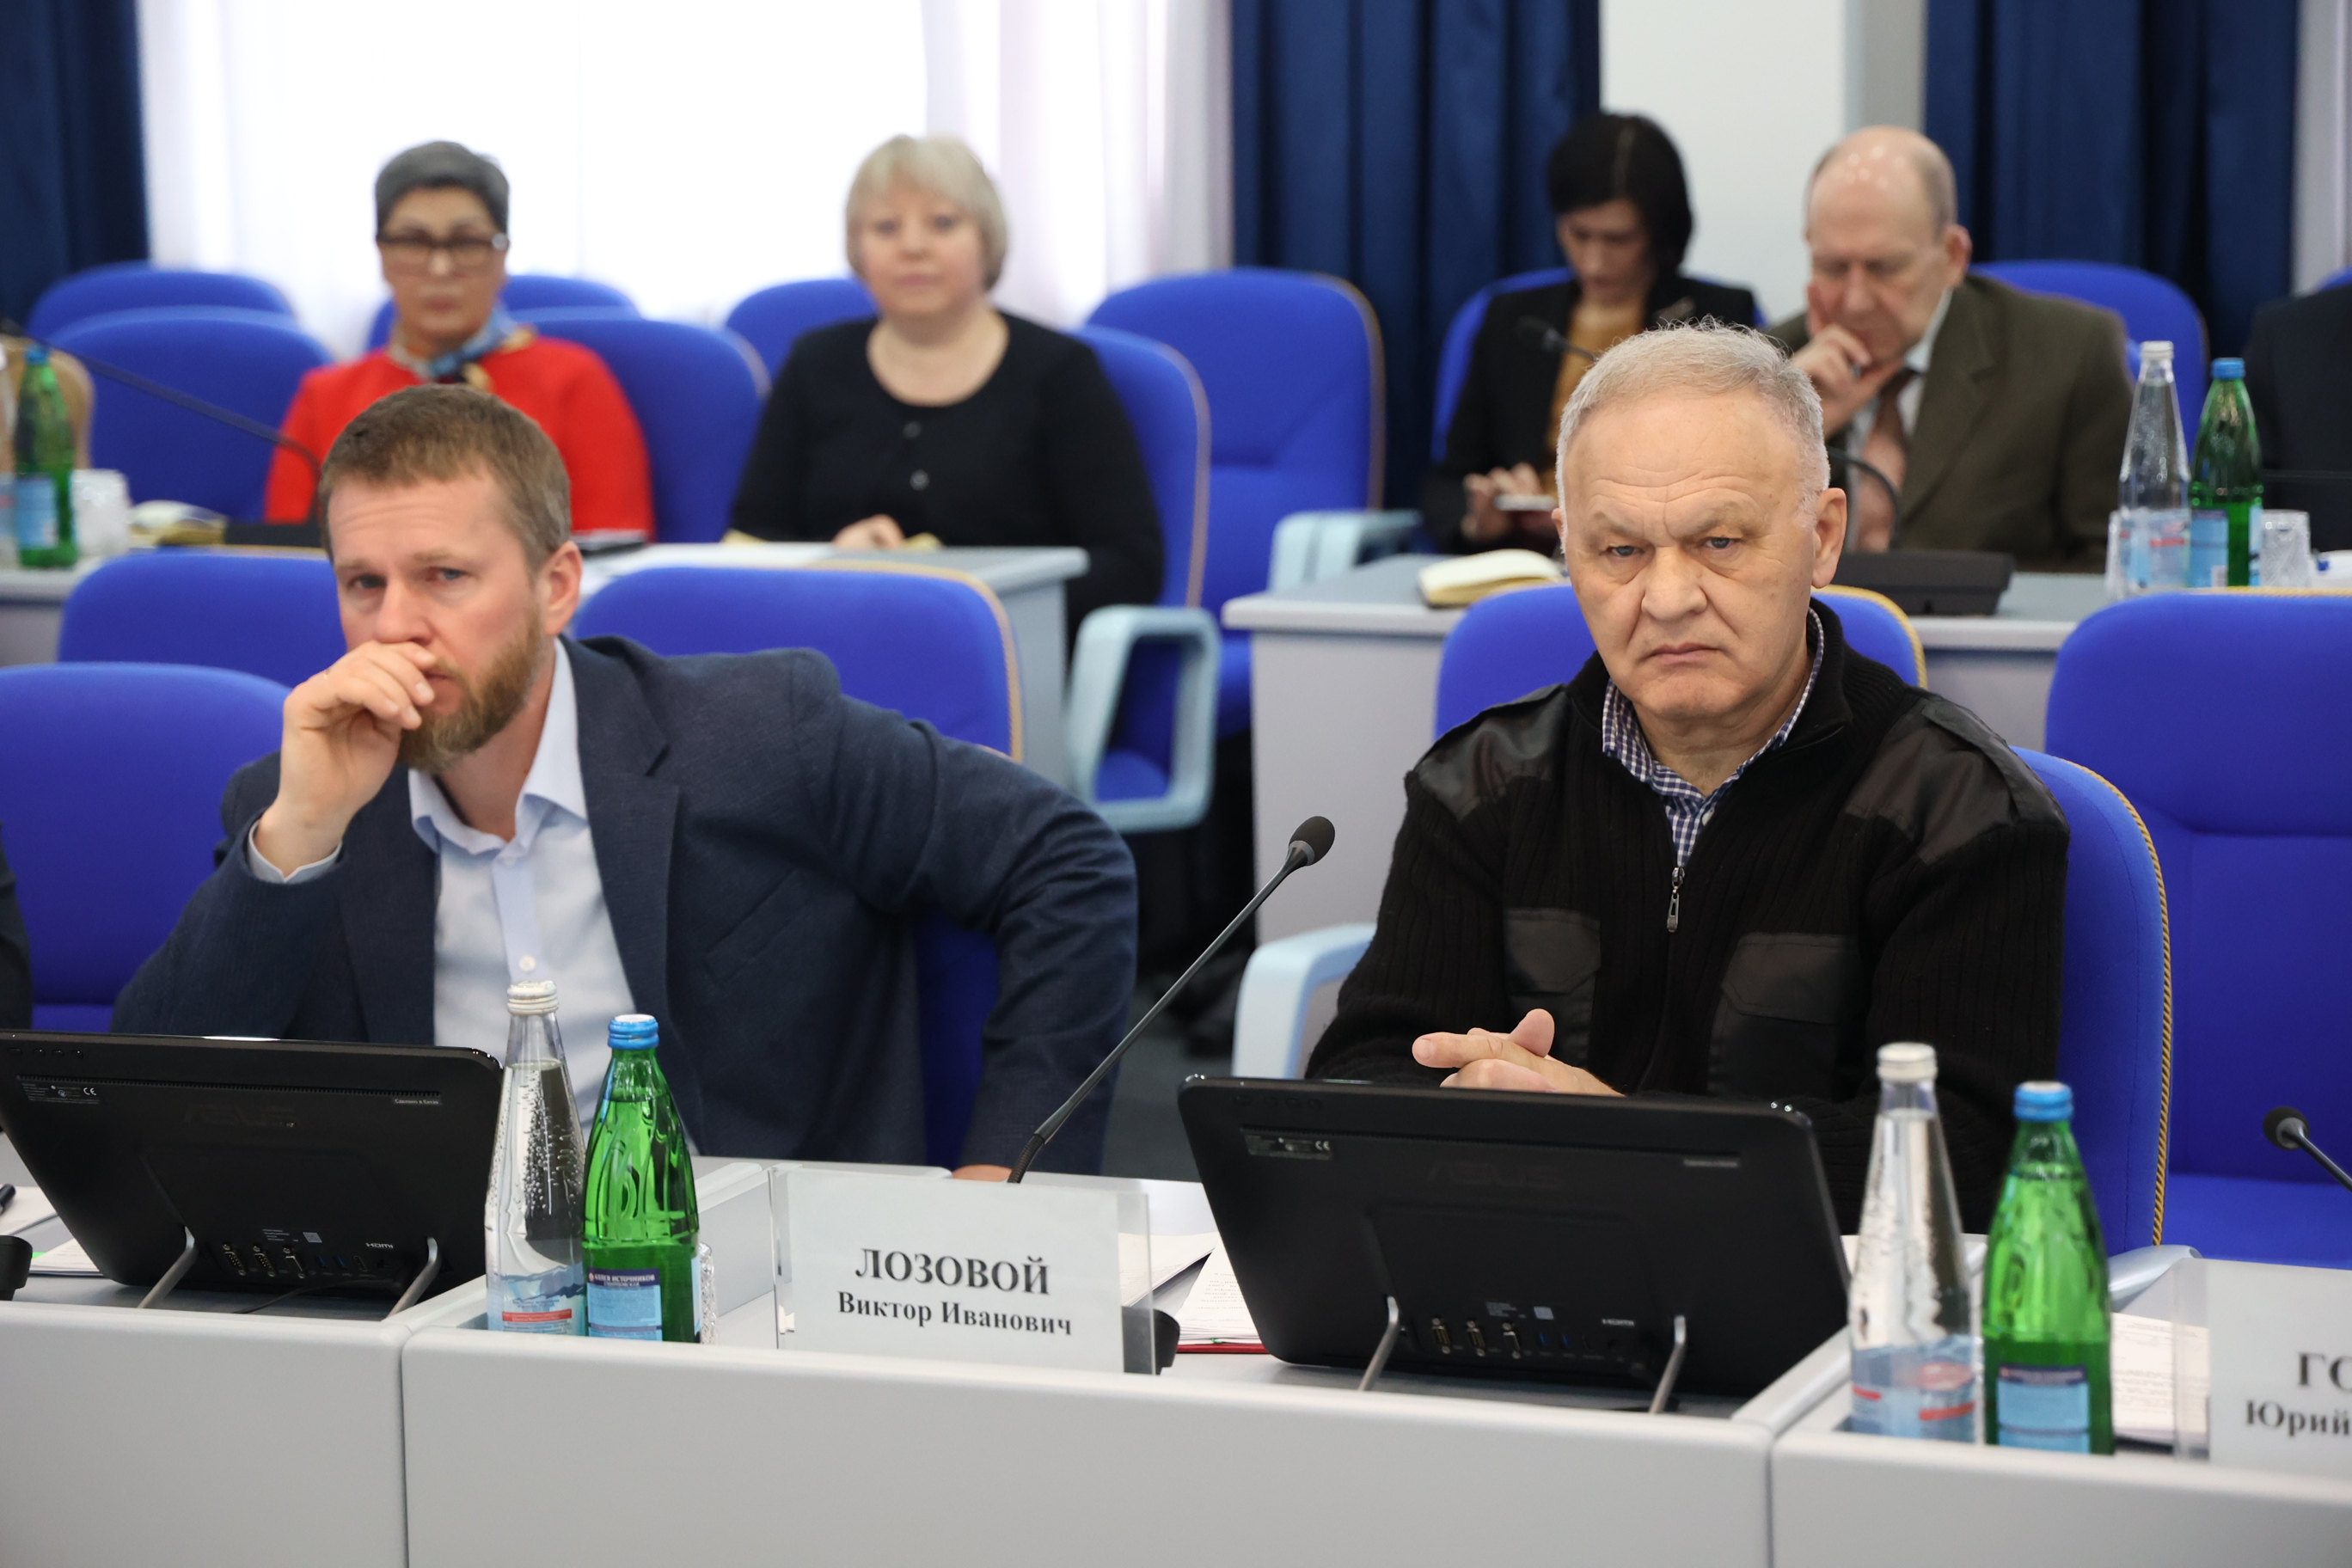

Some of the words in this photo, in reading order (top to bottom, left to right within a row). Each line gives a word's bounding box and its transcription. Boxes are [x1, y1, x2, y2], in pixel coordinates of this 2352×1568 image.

[182, 1103, 301, 1128] ASUS
[1426, 1160, 1566, 1191] ASUS
[854, 1248, 1050, 1295] ЛОЗОВОЙ
[837, 1291, 932, 1327] Виктор
[940, 1301, 1072, 1335] Иванович
[2246, 1399, 2350, 1437] Юрий
